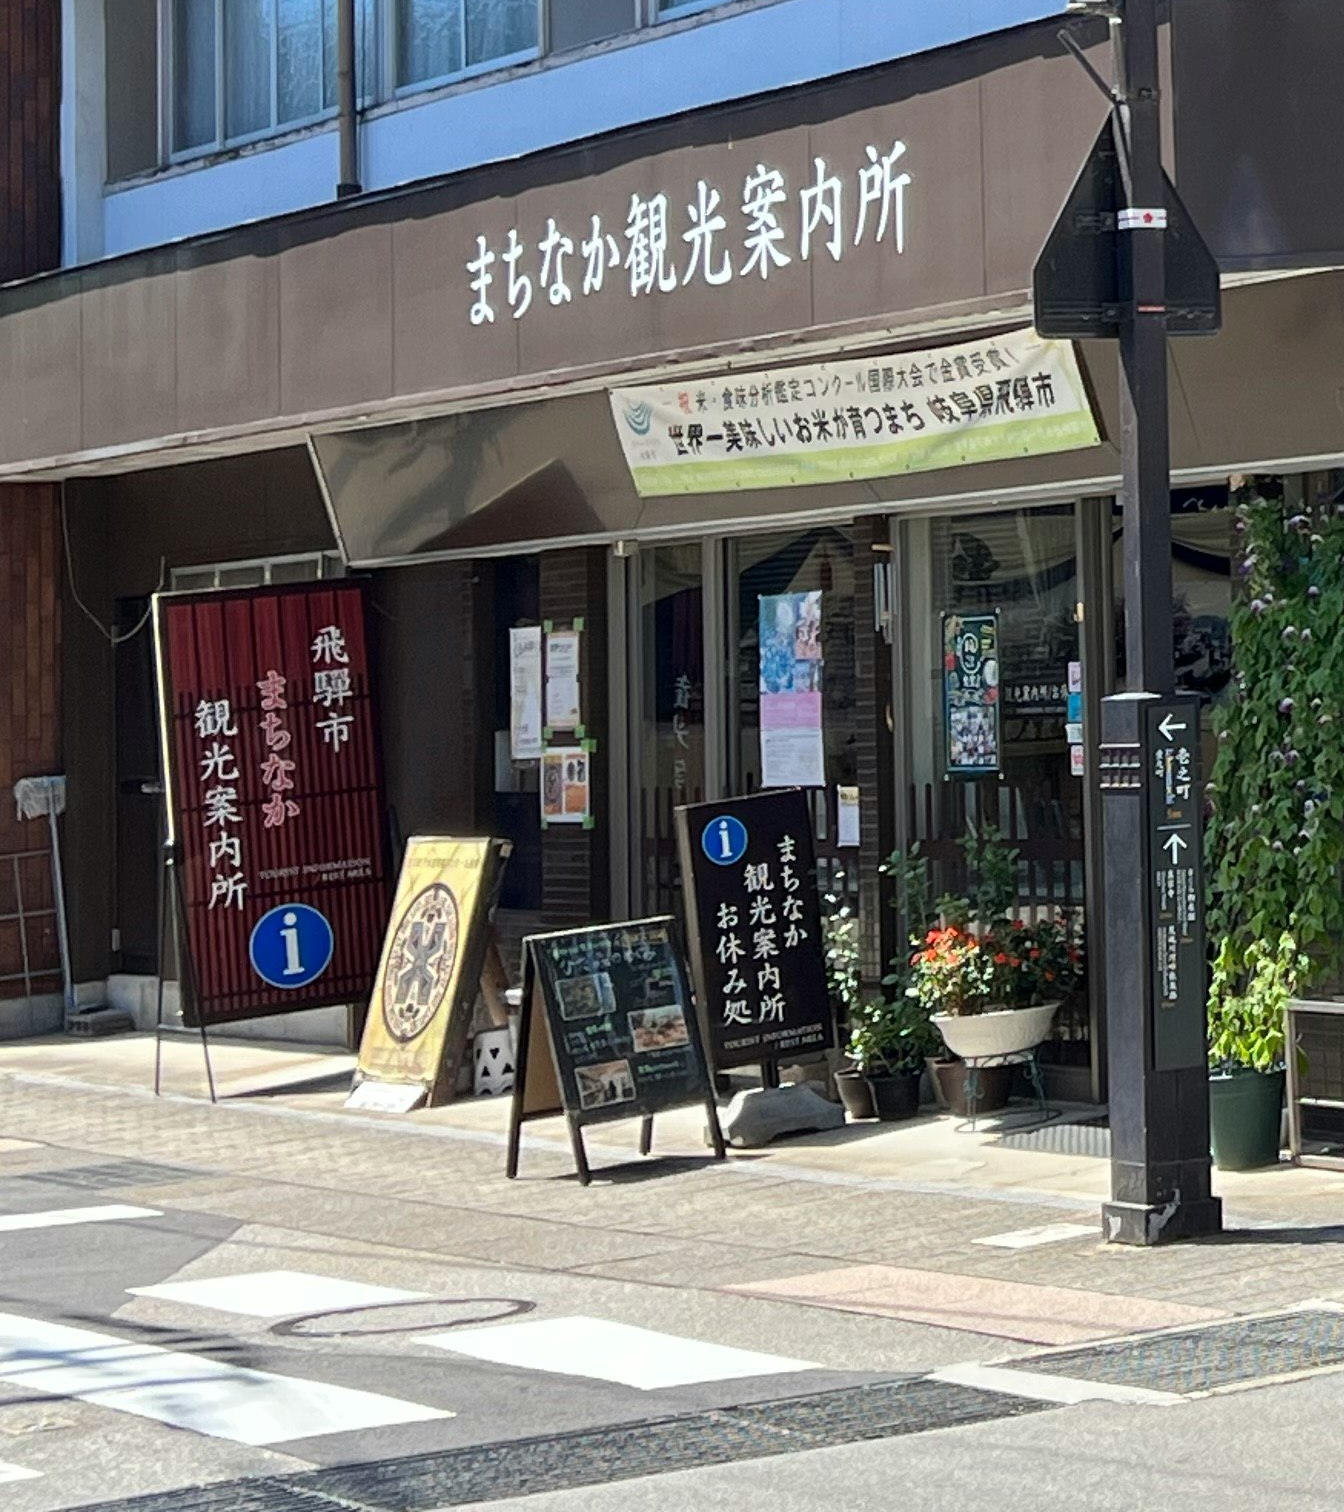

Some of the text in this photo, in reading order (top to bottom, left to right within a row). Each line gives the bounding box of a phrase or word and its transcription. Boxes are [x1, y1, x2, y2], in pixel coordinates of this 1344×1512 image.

[466, 139, 913, 326] まちなか観光案内所
[927, 371, 1056, 424] 岐阜県飛騨市
[257, 670, 300, 828] まちなか
[311, 625, 354, 753] 飛騨市
[195, 699, 248, 911] 観光案内所
[743, 862, 787, 1023] 観光案内所
[777, 835, 808, 948] まちなか
[715, 902, 754, 1027] お休み処
